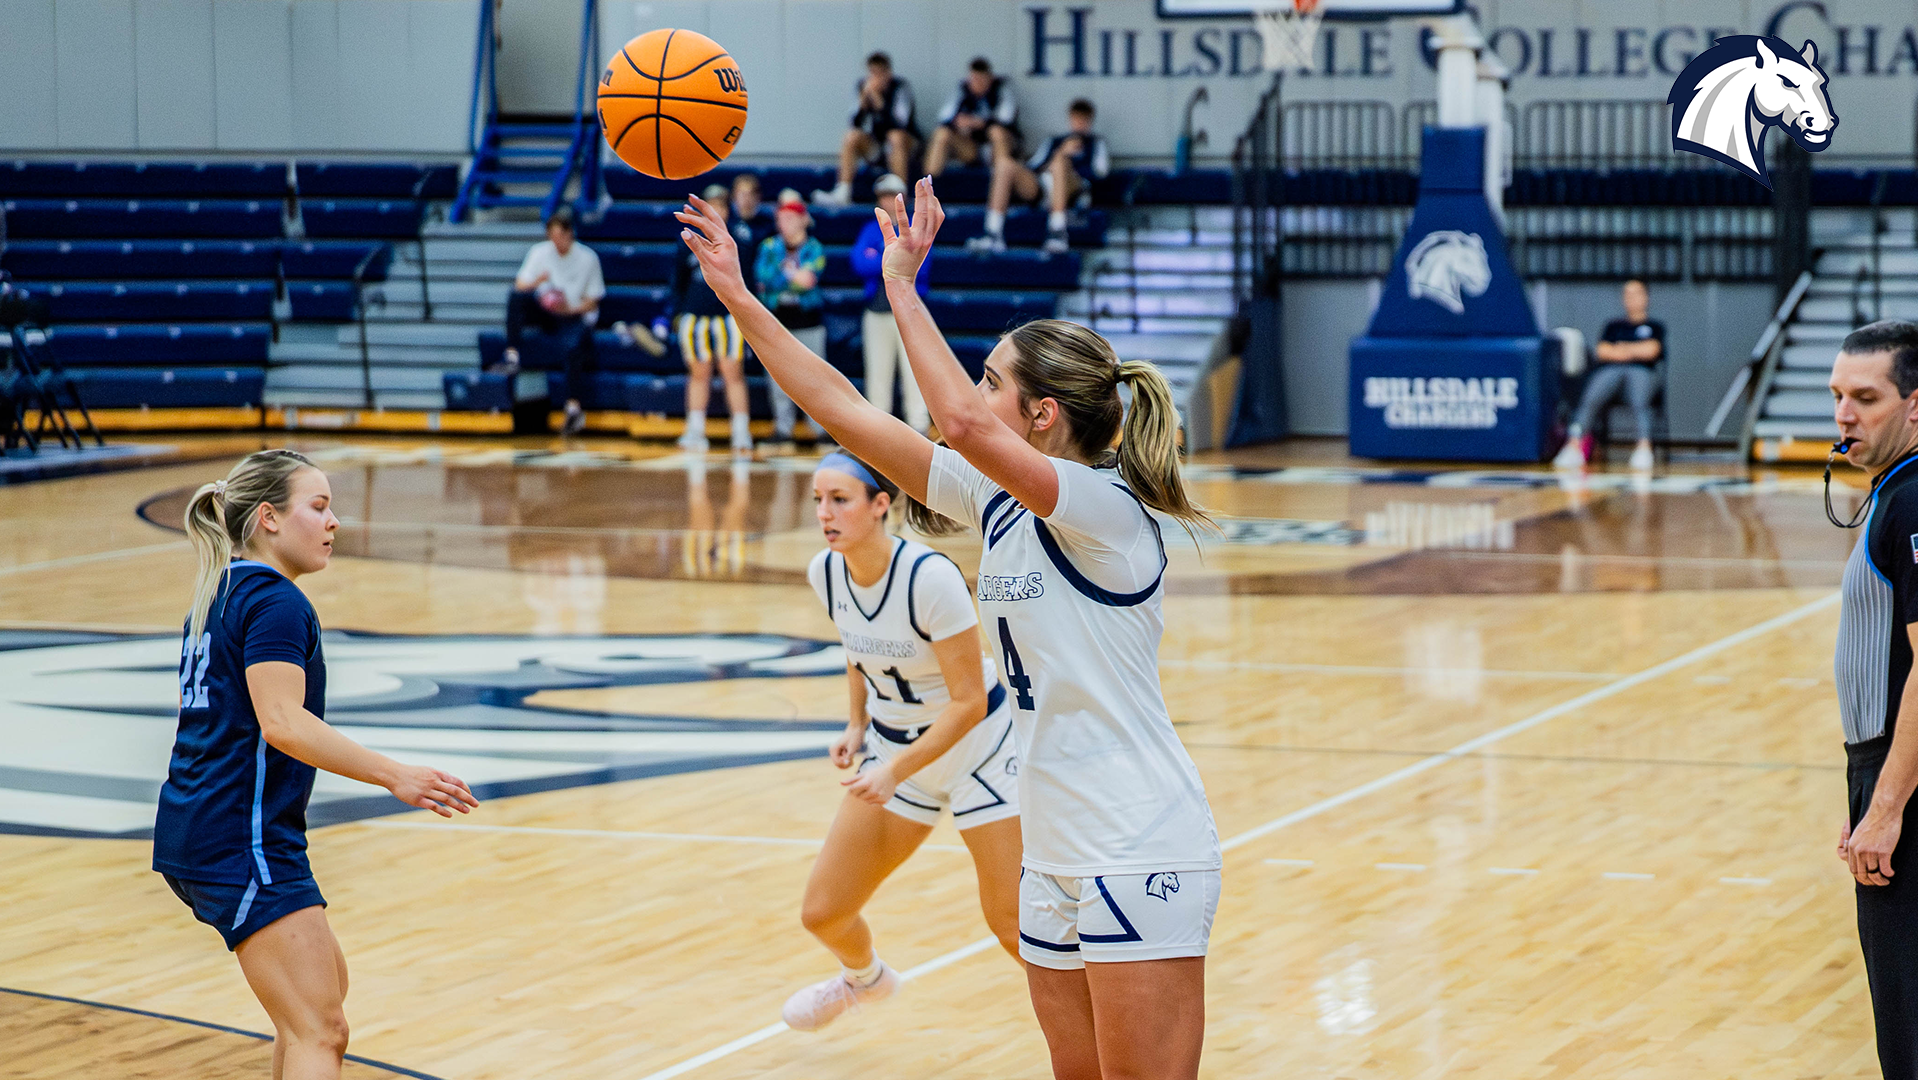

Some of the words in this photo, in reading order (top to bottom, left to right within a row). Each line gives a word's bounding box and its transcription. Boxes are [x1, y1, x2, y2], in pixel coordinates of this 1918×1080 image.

[1025, 7, 1395, 78] HILLSDLE
[1363, 377, 1519, 409] HILLSDALE
[180, 631, 212, 709] 22
[855, 661, 925, 705] 11
[998, 616, 1036, 711] 4
